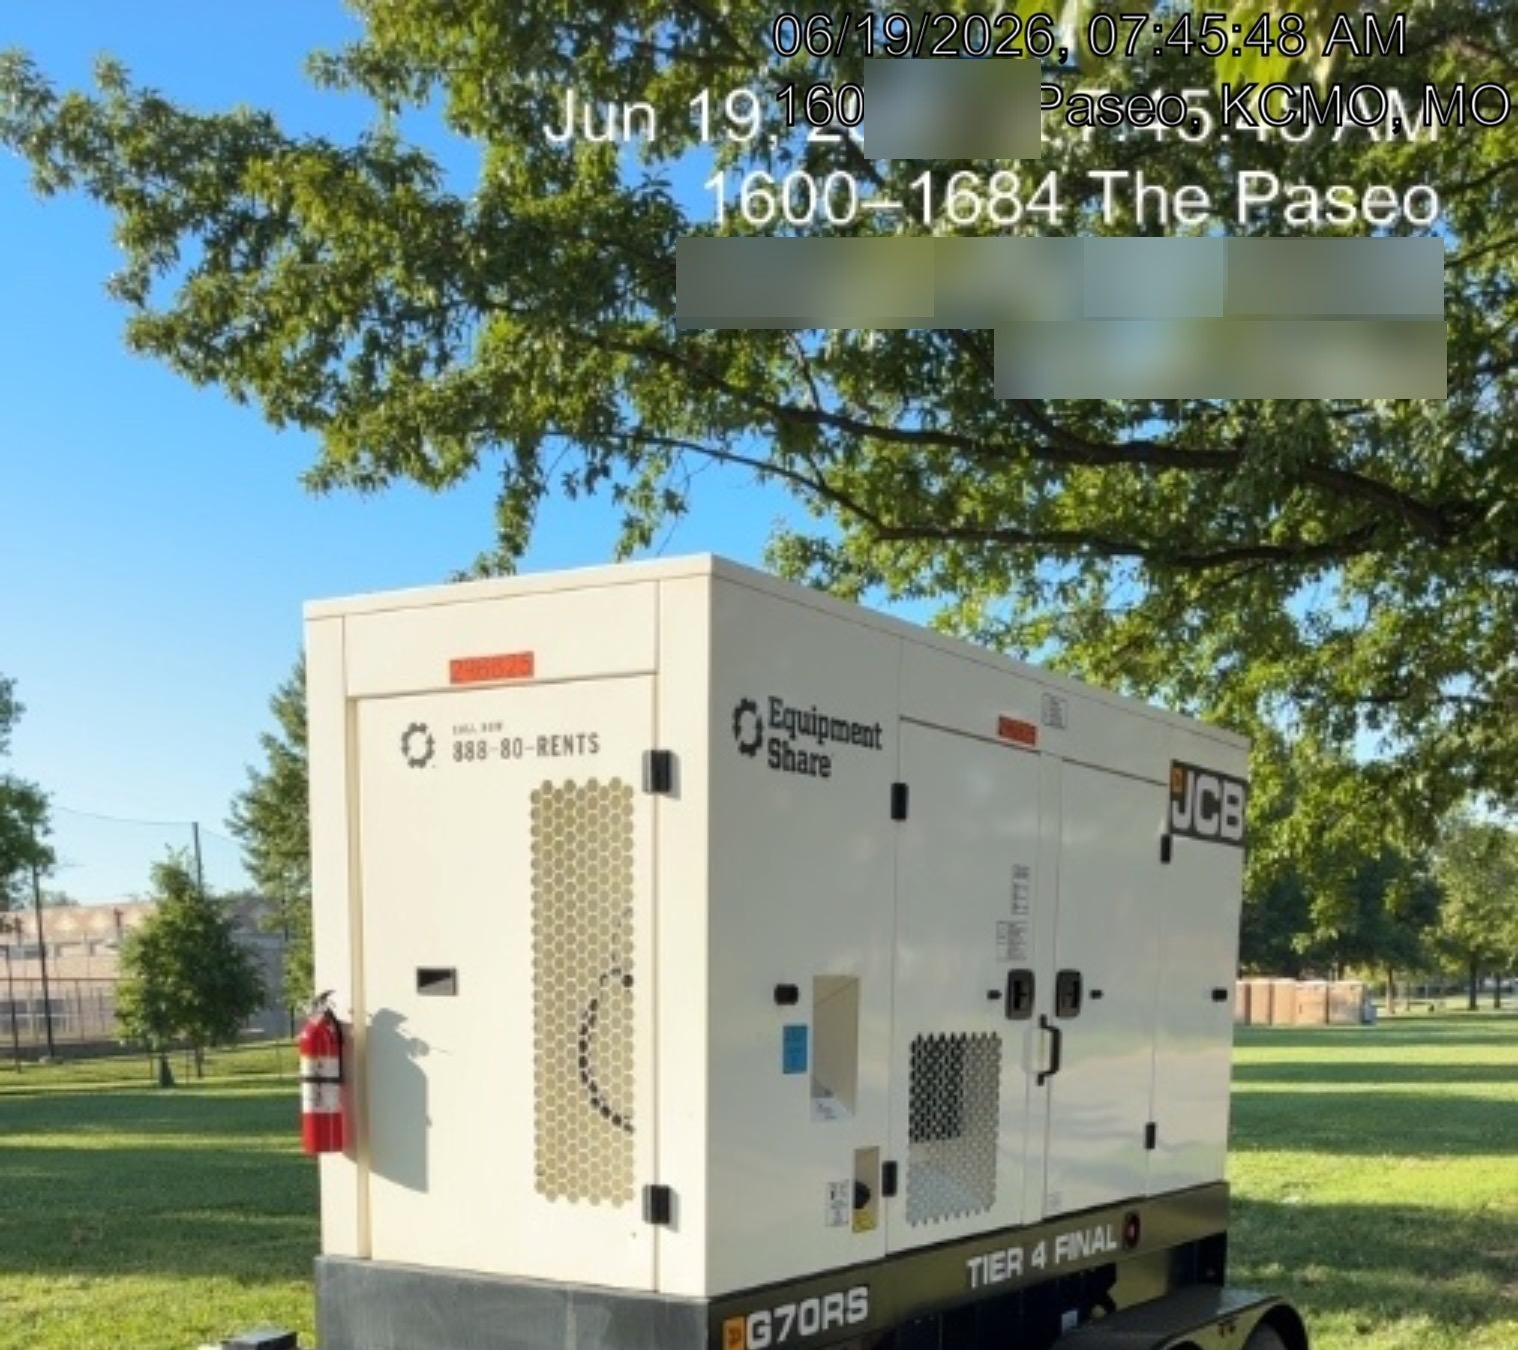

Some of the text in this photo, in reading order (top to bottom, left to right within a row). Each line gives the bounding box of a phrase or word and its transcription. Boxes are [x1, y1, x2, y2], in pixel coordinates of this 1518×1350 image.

[768, 696, 883, 750] Equipment
[768, 737, 832, 778] Share
[1172, 770, 1244, 840] JCB
[966, 1223, 1118, 1289] TIER 4 FINAL
[746, 1286, 869, 1350] G70RS
